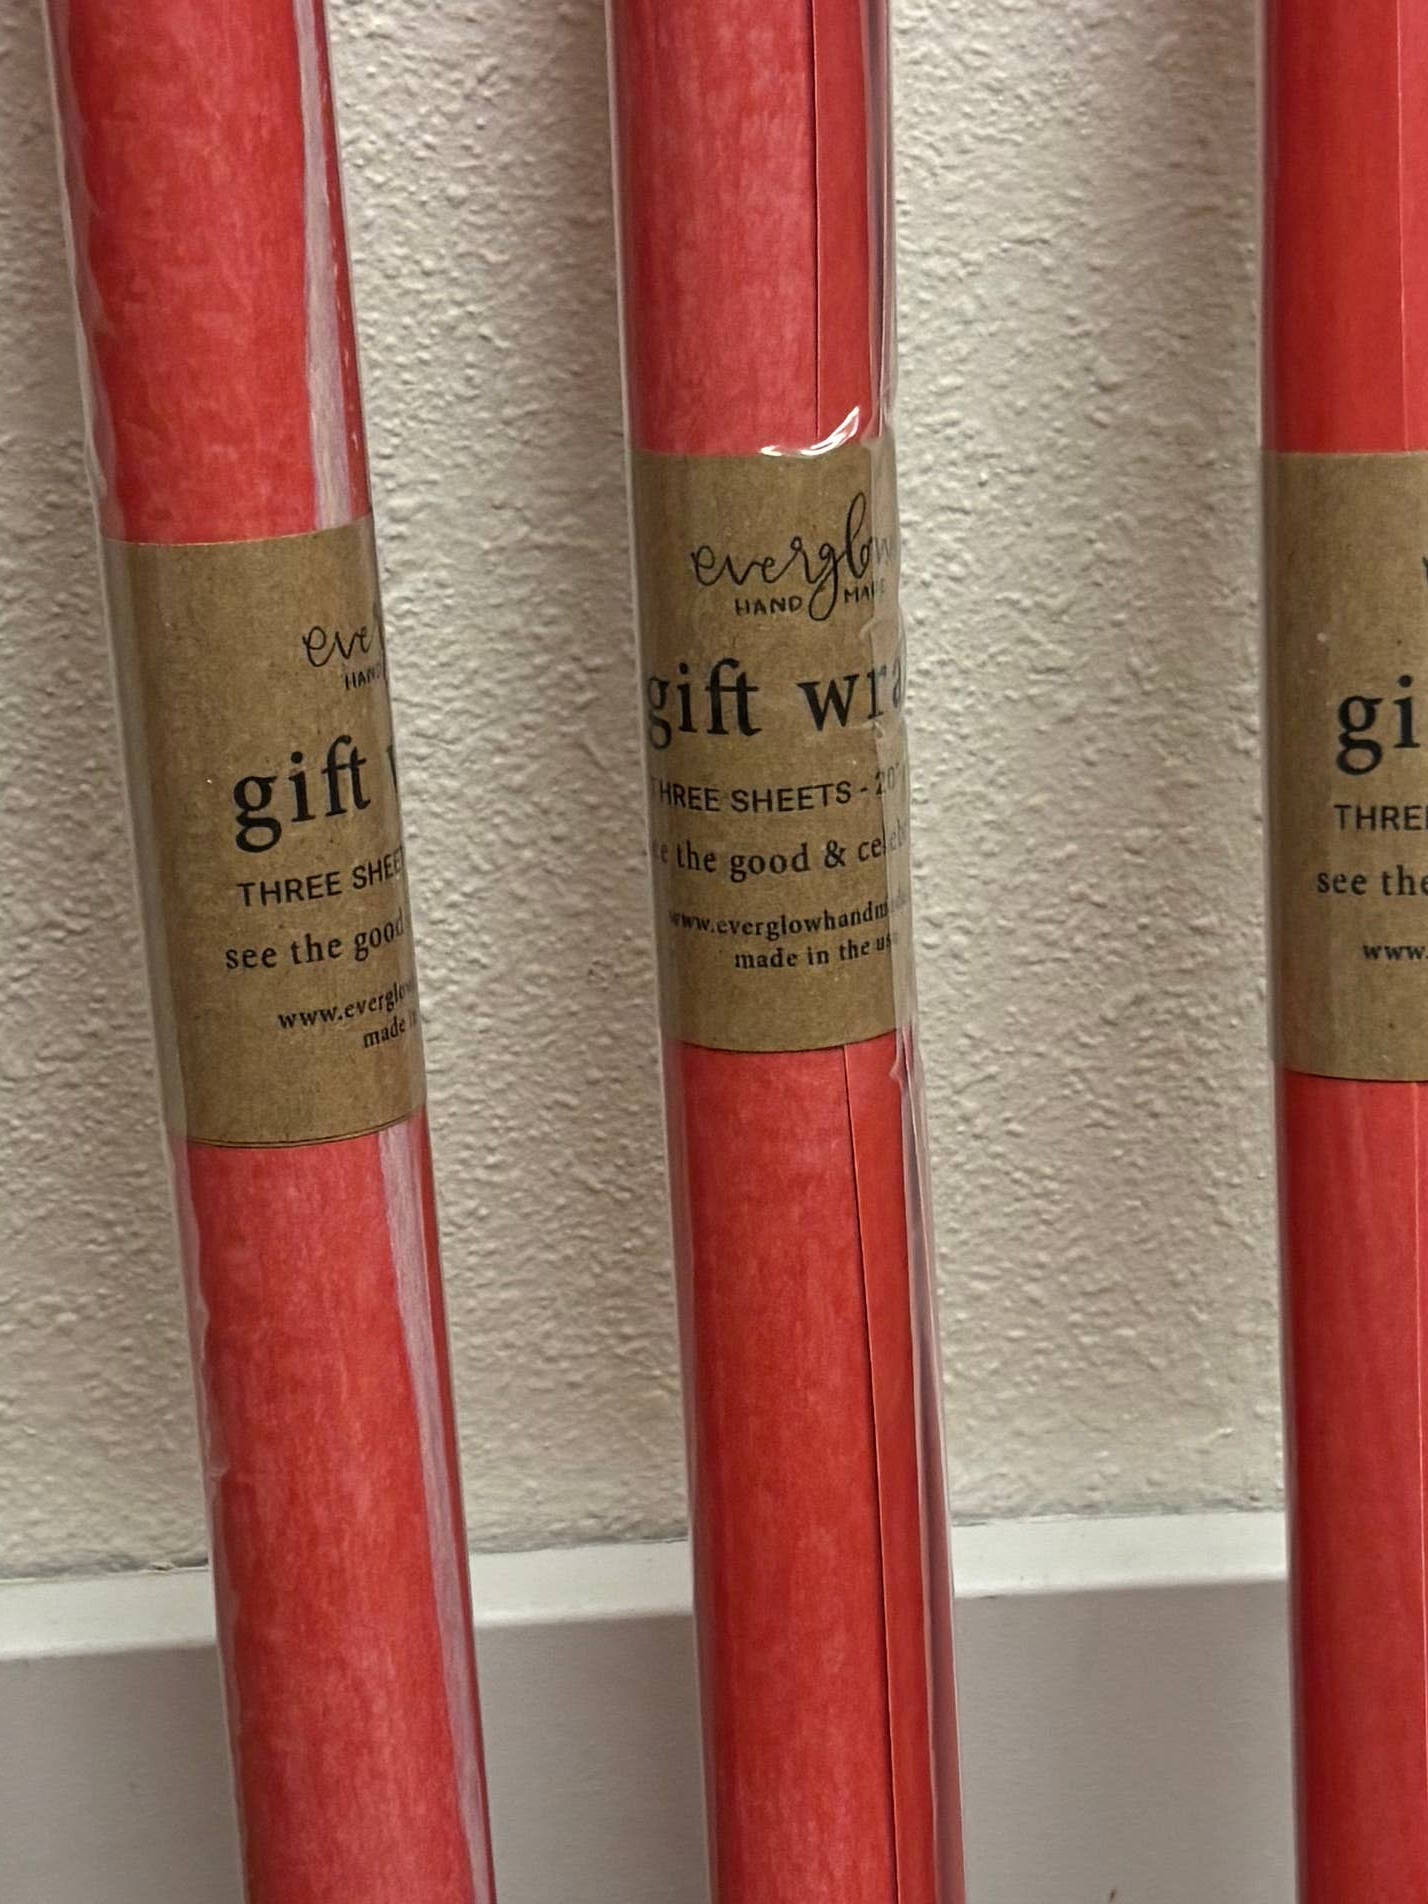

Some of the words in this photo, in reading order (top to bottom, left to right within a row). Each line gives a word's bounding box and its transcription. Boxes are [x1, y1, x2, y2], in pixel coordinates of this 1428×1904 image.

[734, 595, 803, 617] HAND
[647, 657, 763, 751] gift
[233, 734, 371, 854] gift
[730, 780, 852, 814] SHEETS
[677, 840, 716, 873] the
[729, 842, 810, 883] good
[824, 840, 847, 869] &
[235, 870, 343, 908] THREE
[1316, 871, 1368, 895] see
[225, 947, 277, 970] see
[291, 932, 342, 966] the
[353, 906, 404, 963] good
[735, 947, 798, 970] made
[808, 946, 829, 967] in
[839, 938, 870, 961] the
[362, 1015, 406, 1049] made
